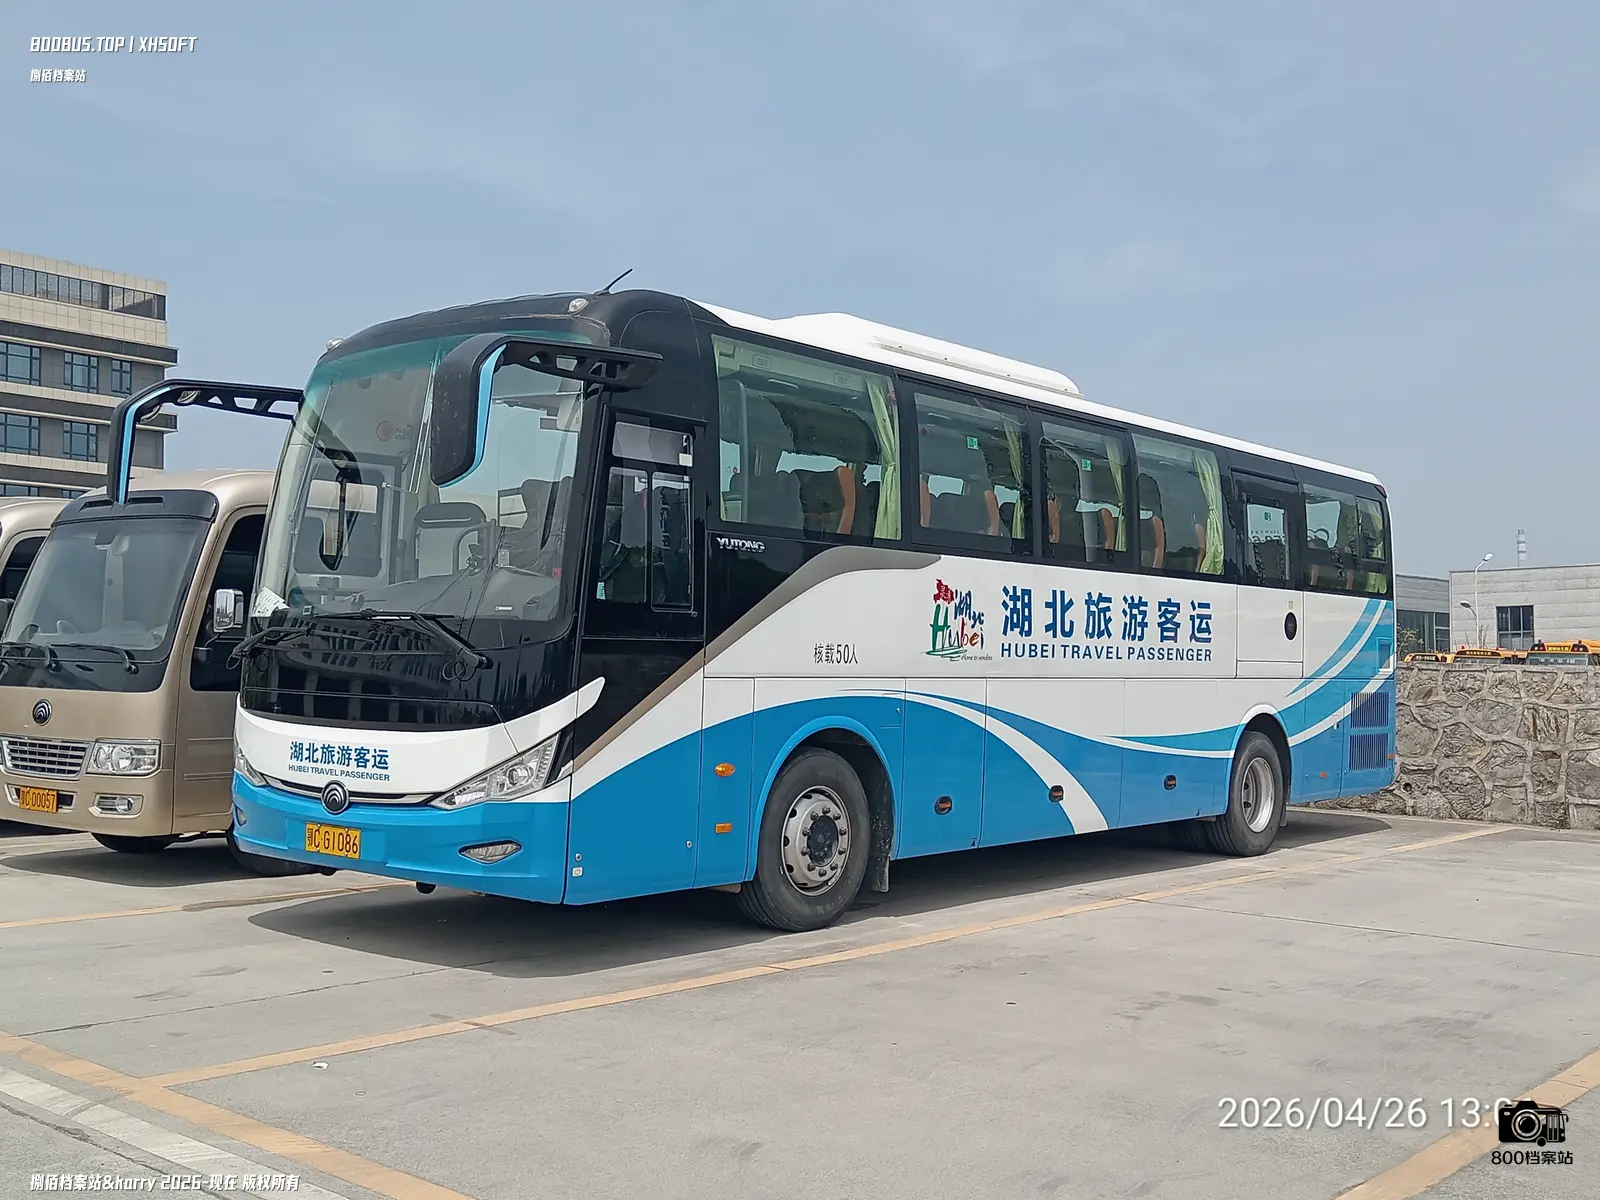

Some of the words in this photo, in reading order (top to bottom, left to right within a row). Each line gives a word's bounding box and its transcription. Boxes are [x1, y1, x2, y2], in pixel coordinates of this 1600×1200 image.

[716, 537, 766, 553] YUTONG
[1001, 585, 1212, 643] 湖北旅游客运
[929, 603, 984, 651] Hubei
[813, 643, 859, 664] 核载50人
[1001, 643, 1055, 659] HUBEI
[1060, 644, 1123, 660] TRAVEL
[1127, 646, 1212, 662] PASSENGER
[290, 741, 389, 770] 湖北旅游客运
[288, 764, 309, 773] HUBEI
[310, 766, 339, 777] TRAVEL
[340, 769, 390, 781] PASSENGER
